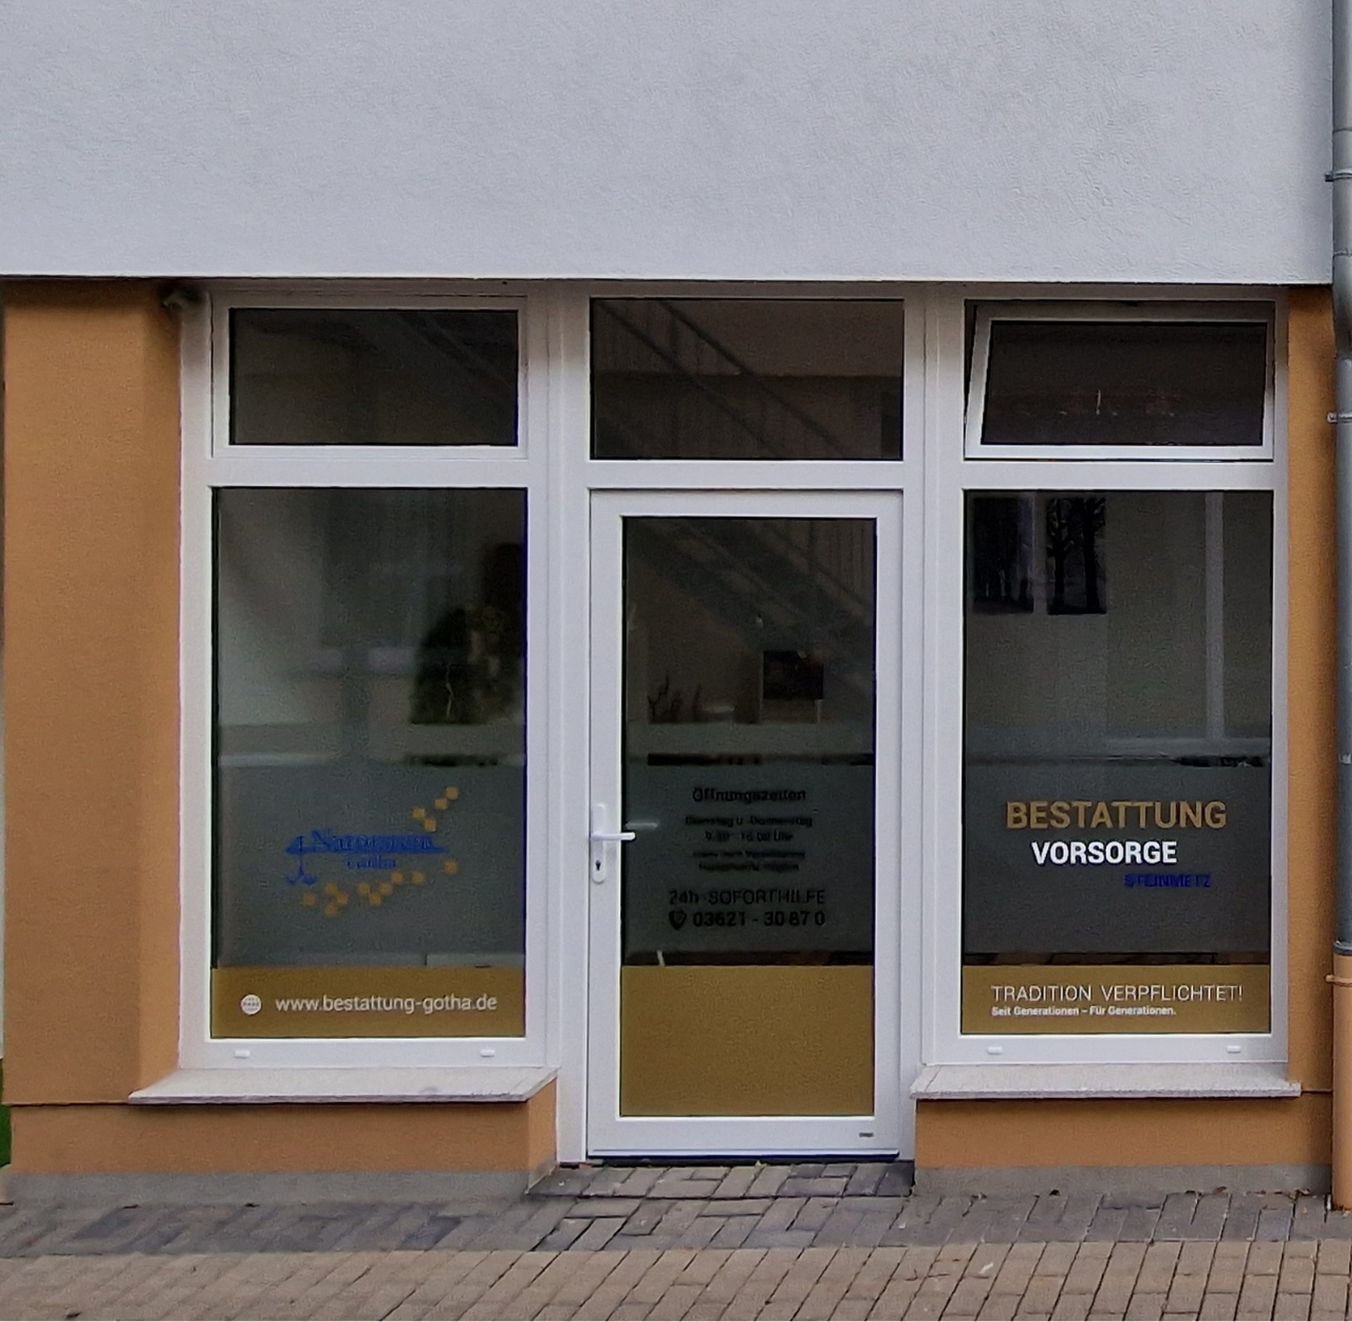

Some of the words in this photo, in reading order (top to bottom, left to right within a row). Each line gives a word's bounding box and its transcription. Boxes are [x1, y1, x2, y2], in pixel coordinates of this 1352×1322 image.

[1006, 800, 1227, 829] BESTATTUNG
[1031, 841, 1177, 865] VORSORGE
[692, 911, 745, 927] 03621
[992, 985, 1091, 1001] TRADITION
[1101, 984, 1243, 1001] VERPFLICHTET!
[275, 995, 497, 1014] www.bestattung-gotha.de
[992, 1006, 1010, 1016] Seit
[1014, 1006, 1079, 1016] Generationen
[1090, 1005, 1105, 1016] Für
[1108, 1005, 1176, 1016] Generationen.
